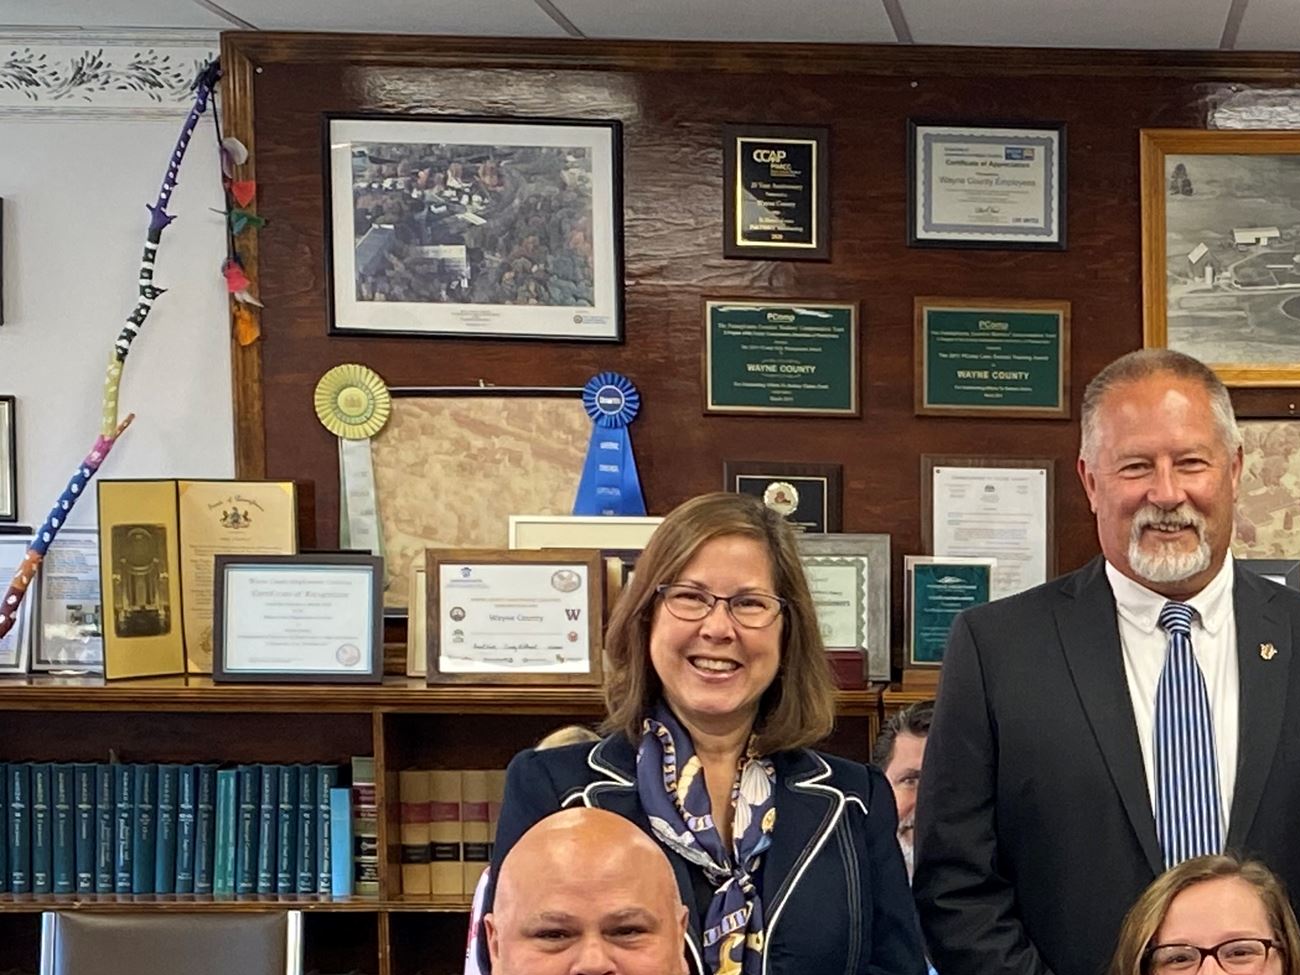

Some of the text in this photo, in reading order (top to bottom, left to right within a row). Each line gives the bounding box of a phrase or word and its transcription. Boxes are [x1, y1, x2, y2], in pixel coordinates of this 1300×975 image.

[753, 149, 786, 163] CCAP
[968, 178, 993, 186] County
[979, 321, 1008, 330] PComp
[747, 364, 816, 373] WAYNE COUNTY
[992, 371, 1029, 379] COUNTY
[565, 609, 581, 621] W
